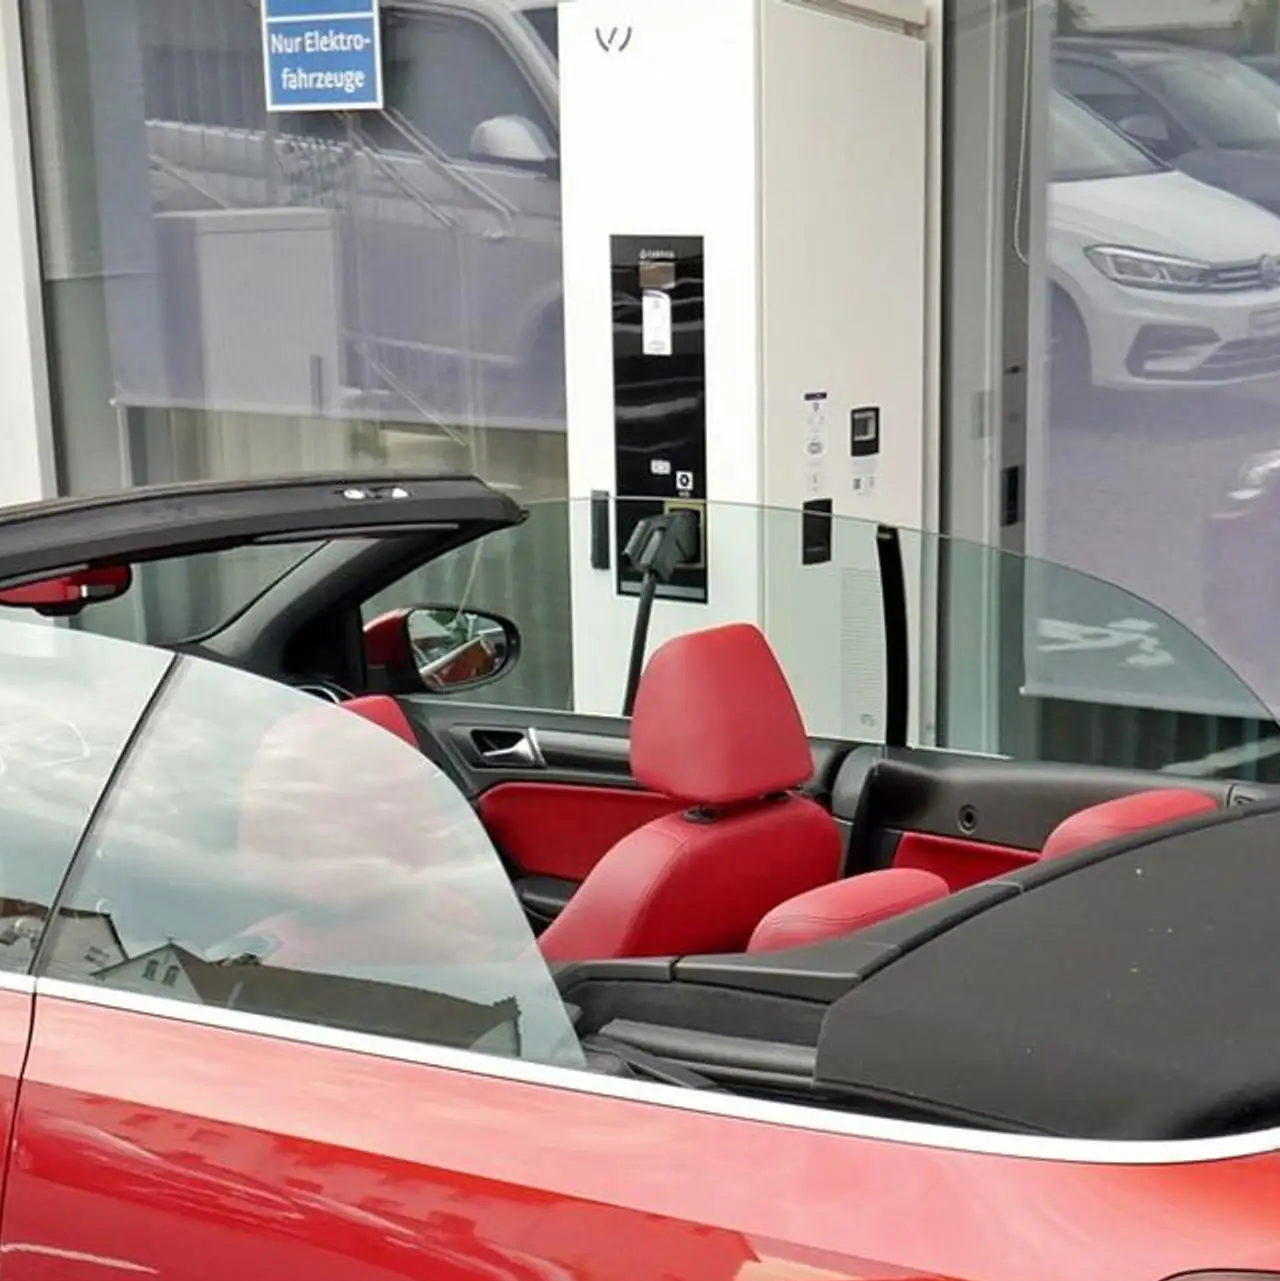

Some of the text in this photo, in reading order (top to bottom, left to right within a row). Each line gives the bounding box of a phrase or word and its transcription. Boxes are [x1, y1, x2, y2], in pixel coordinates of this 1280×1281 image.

[271, 30, 371, 54] Nur Elektro-
[281, 68, 366, 93] fahrzeuge
